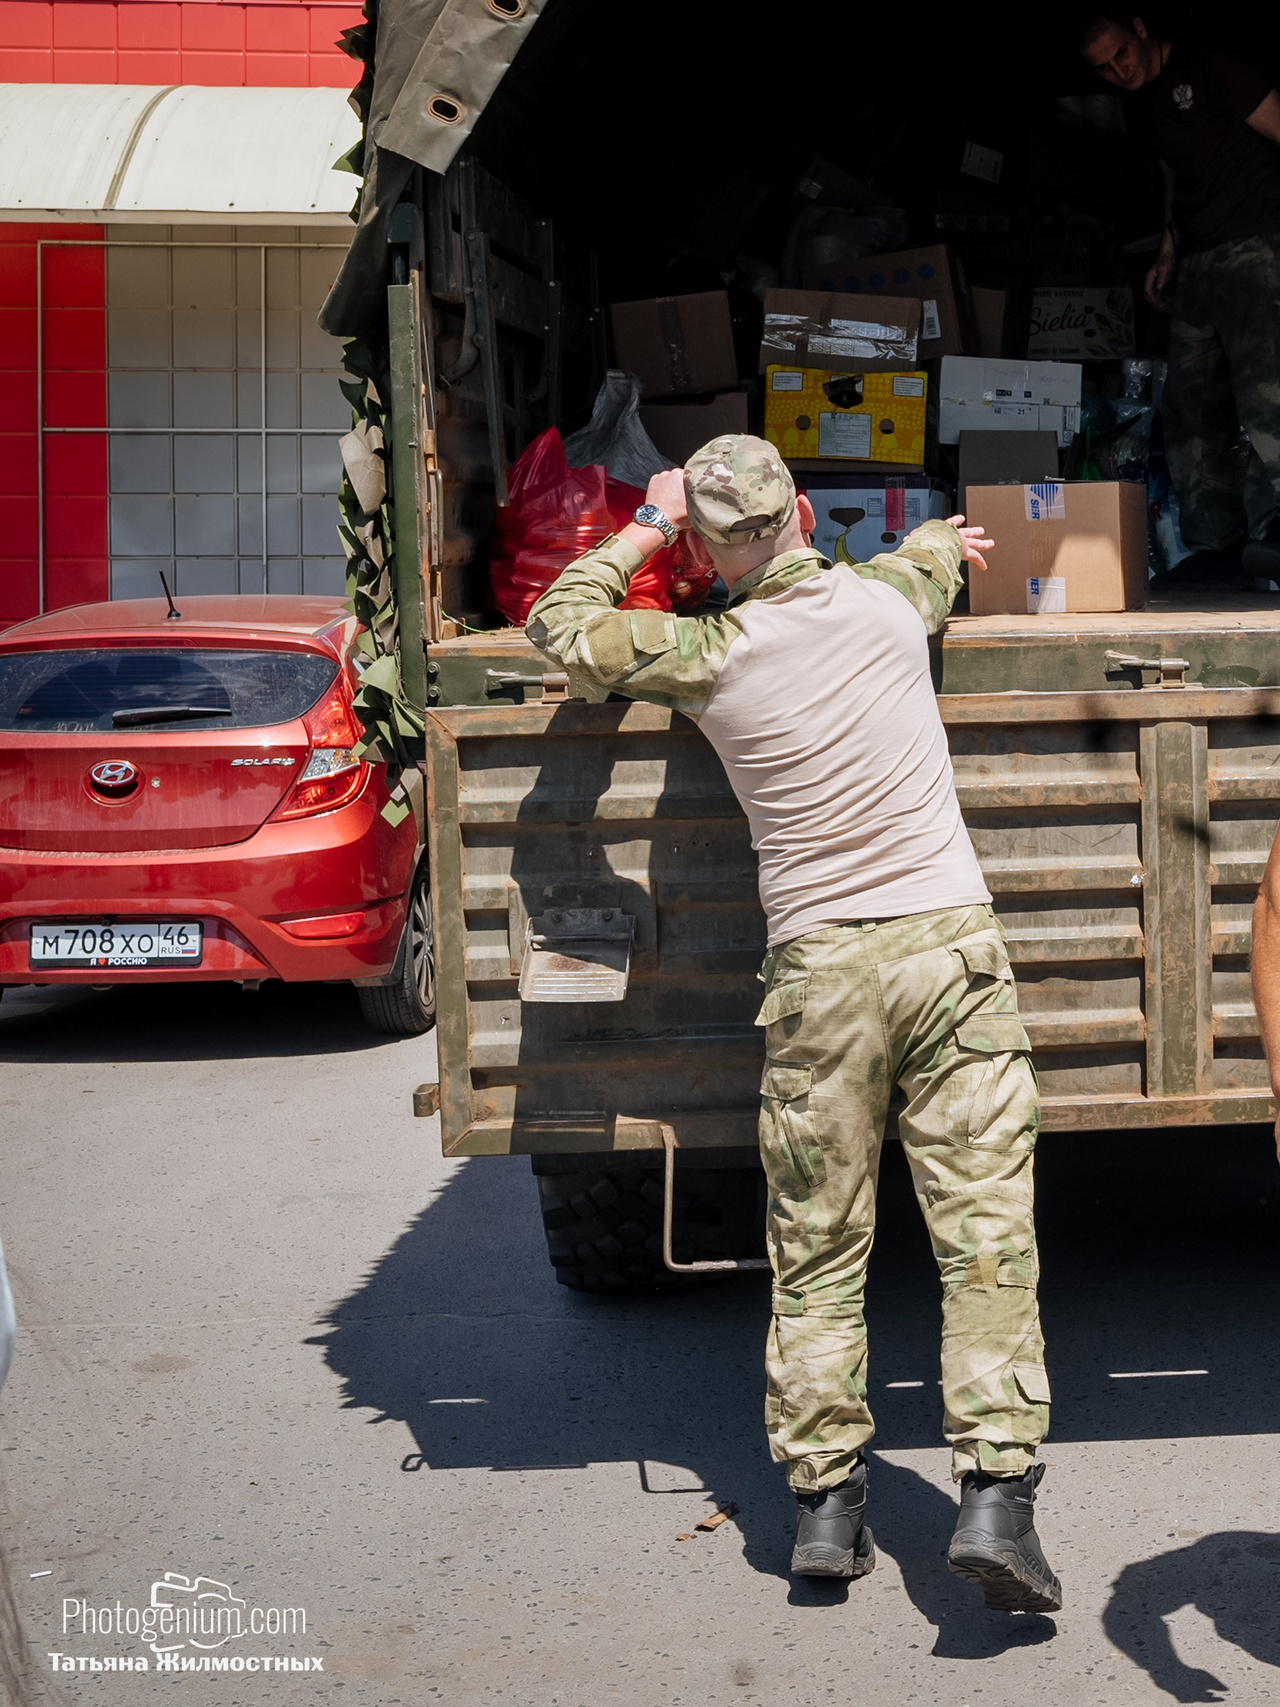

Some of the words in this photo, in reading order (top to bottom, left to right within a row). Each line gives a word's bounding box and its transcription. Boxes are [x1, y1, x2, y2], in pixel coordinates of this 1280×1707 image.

[1029, 302, 1091, 336] Sielia
[230, 758, 295, 766] SOLARIS
[163, 926, 189, 945] 46
[161, 946, 181, 954] RUS
[108, 957, 148, 965] РОССИЮ
